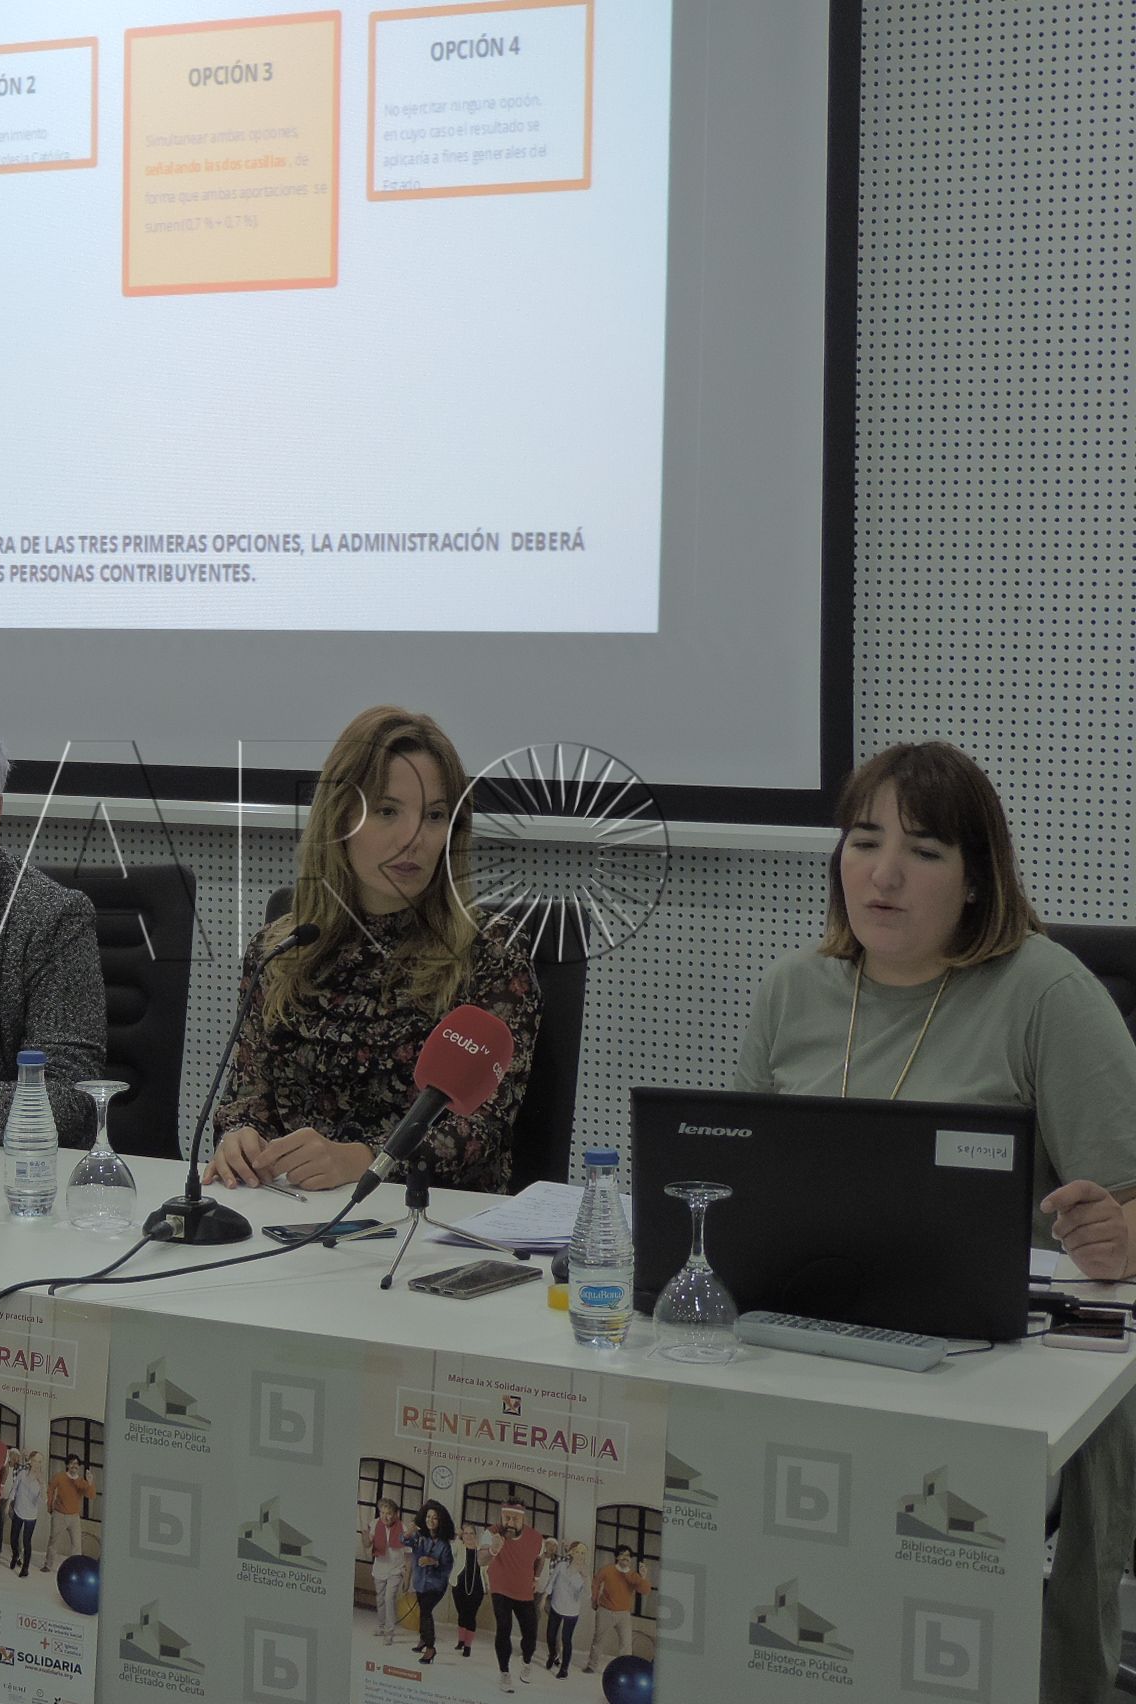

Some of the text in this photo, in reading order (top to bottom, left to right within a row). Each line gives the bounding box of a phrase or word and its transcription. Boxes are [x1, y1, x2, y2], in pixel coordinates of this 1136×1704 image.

[431, 33, 521, 61] OPCIÓN 4
[26, 76, 36, 94] 2
[188, 59, 273, 87] OPCIÓN 3
[20, 536, 40, 555] DE
[45, 535, 75, 554] LAS
[78, 535, 118, 554] TRES
[122, 534, 207, 553] PRIMERAS
[213, 534, 304, 555] OPCIONES,
[311, 533, 333, 552] LA
[338, 527, 499, 552] ADMINISTRACIÓN
[512, 526, 585, 551] DEBERÁ
[10, 563, 95, 582] PERSONAS
[100, 563, 255, 582] CONTRIBUYENTES.
[442, 1028, 479, 1055] ceuta
[678, 1122, 753, 1138] lenovo
[448, 1374, 474, 1385] Marca
[494, 1381, 532, 1394] Solidaria
[534, 1388, 539, 1396] y
[541, 1390, 577, 1401] practica
[579, 1393, 587, 1402] la
[124, 1432, 210, 1453] del Estado en Ceuta
[130, 1423, 206, 1443] Biblioteca Pública
[403, 1405, 618, 1461] RENTATERAPIA
[895, 1549, 1005, 1576] del Estado en Ceuta
[901, 1540, 999, 1564] Biblioteca Pública
[236, 1572, 326, 1595] del Estado en Ceuta
[242, 1562, 322, 1585] Biblioteca Pública
[18, 1616, 37, 1629] 106
[17, 1652, 82, 1675] SOLIDARIA
[748, 1659, 853, 1686] del Estado en Ceuta
[753, 1649, 848, 1673] Biblioteca Pública
[119, 1672, 204, 1697] del Estado en Ceuta
[124, 1663, 200, 1686] Biblioteca Pública
